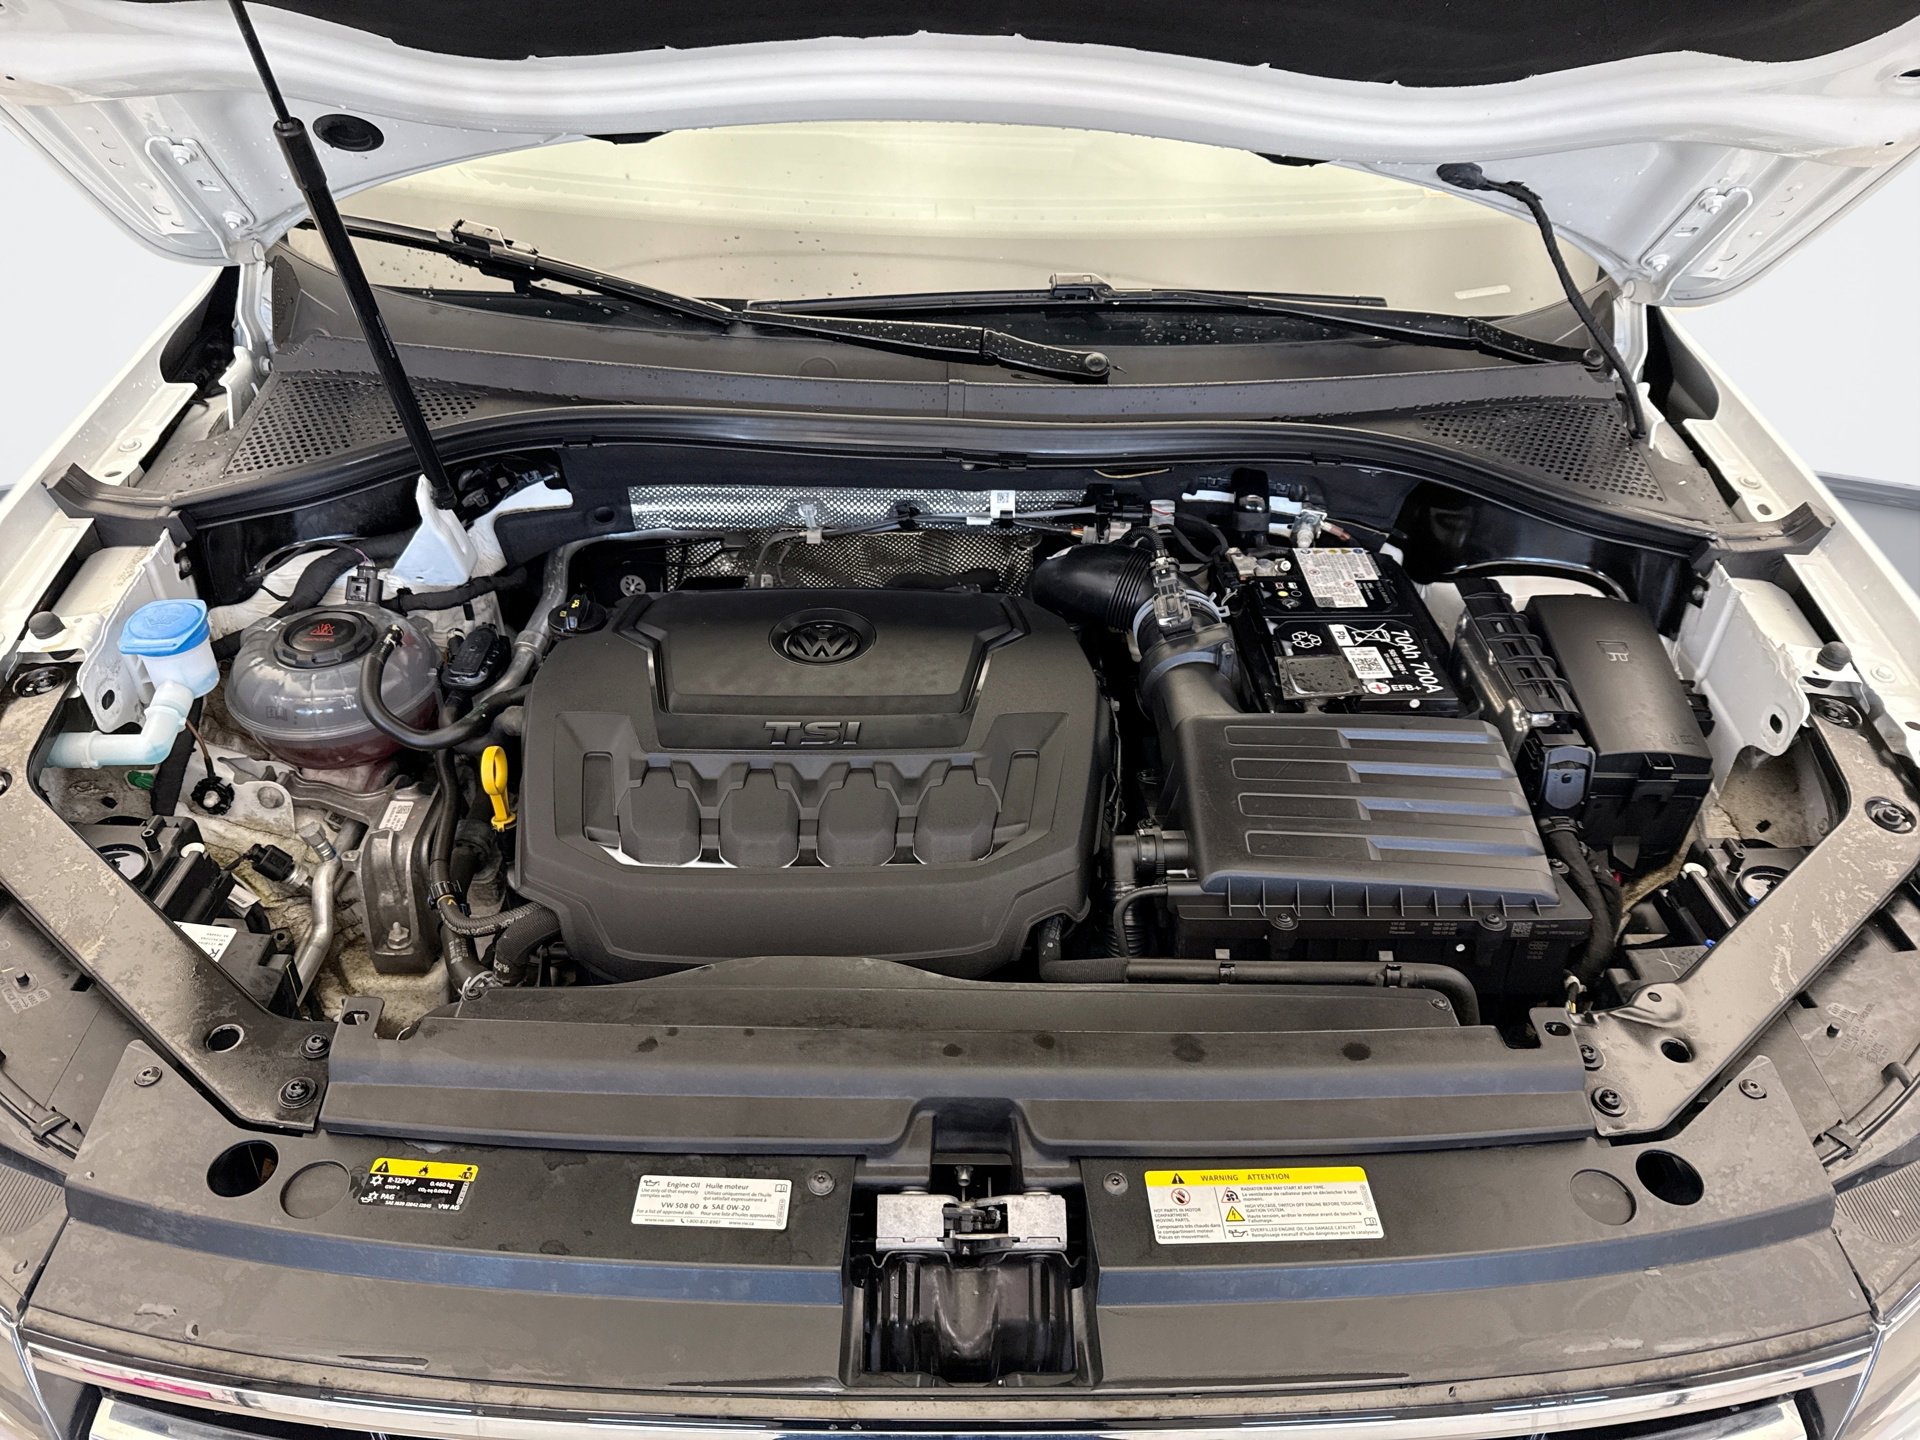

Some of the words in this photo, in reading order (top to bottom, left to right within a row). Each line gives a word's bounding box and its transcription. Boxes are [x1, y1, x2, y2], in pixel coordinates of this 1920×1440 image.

[1335, 630, 1346, 640] Pb
[1390, 629, 1422, 659] 70Ah
[1409, 661, 1444, 694] 700A
[1391, 684, 1422, 692] EFB+
[763, 721, 861, 745] TSI
[387, 1176, 416, 1186] R-1234yf
[1200, 1174, 1239, 1182] WARNING
[1247, 1173, 1290, 1181] ATTENTION
[667, 1181, 689, 1189] Engine
